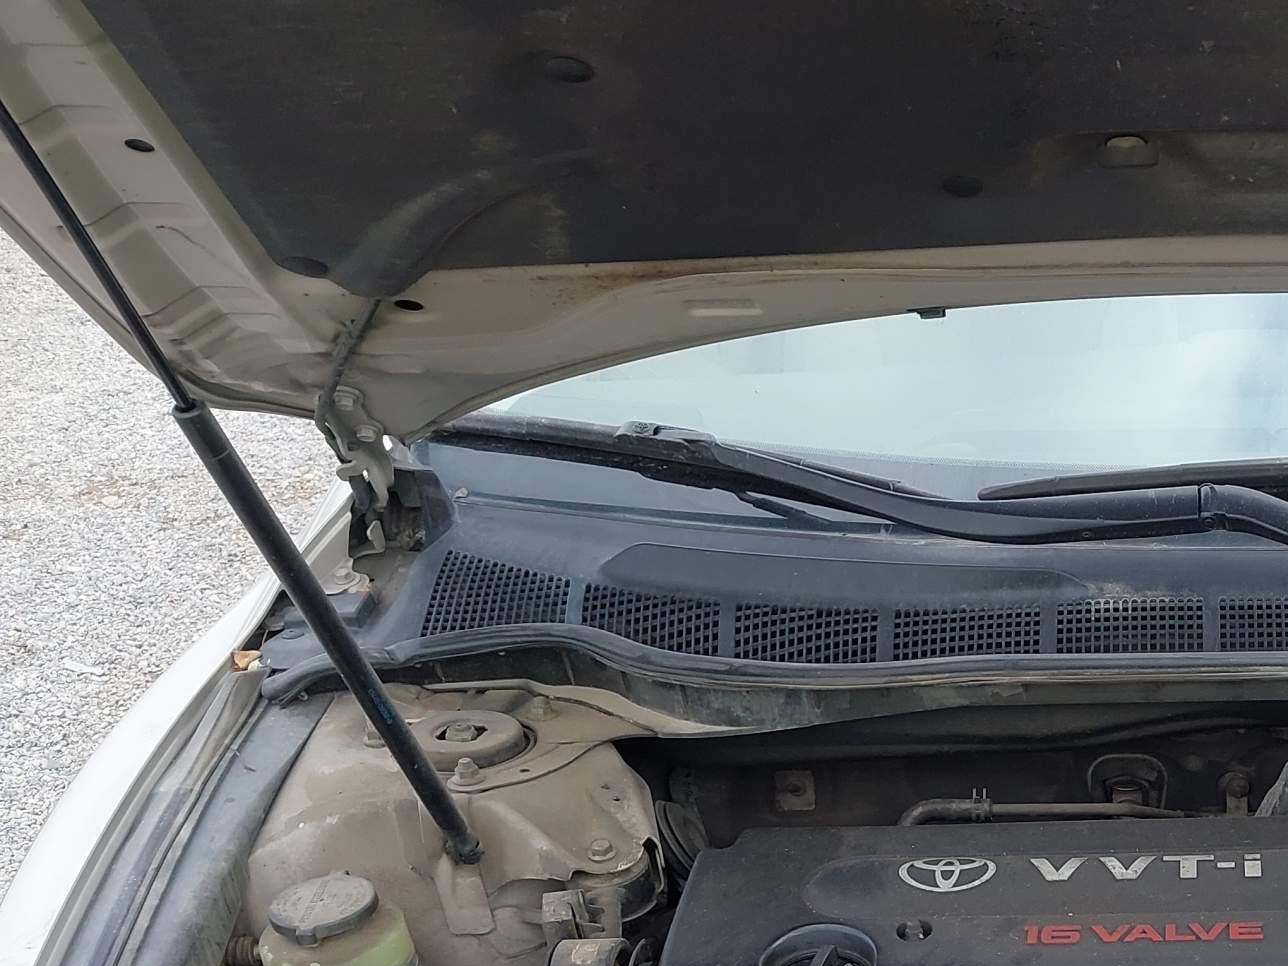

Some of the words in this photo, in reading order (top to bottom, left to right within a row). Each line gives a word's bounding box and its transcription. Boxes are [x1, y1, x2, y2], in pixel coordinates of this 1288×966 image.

[1030, 854, 1262, 881] VVT-i
[1024, 925, 1081, 944] 16
[1091, 922, 1264, 942] VALVE
